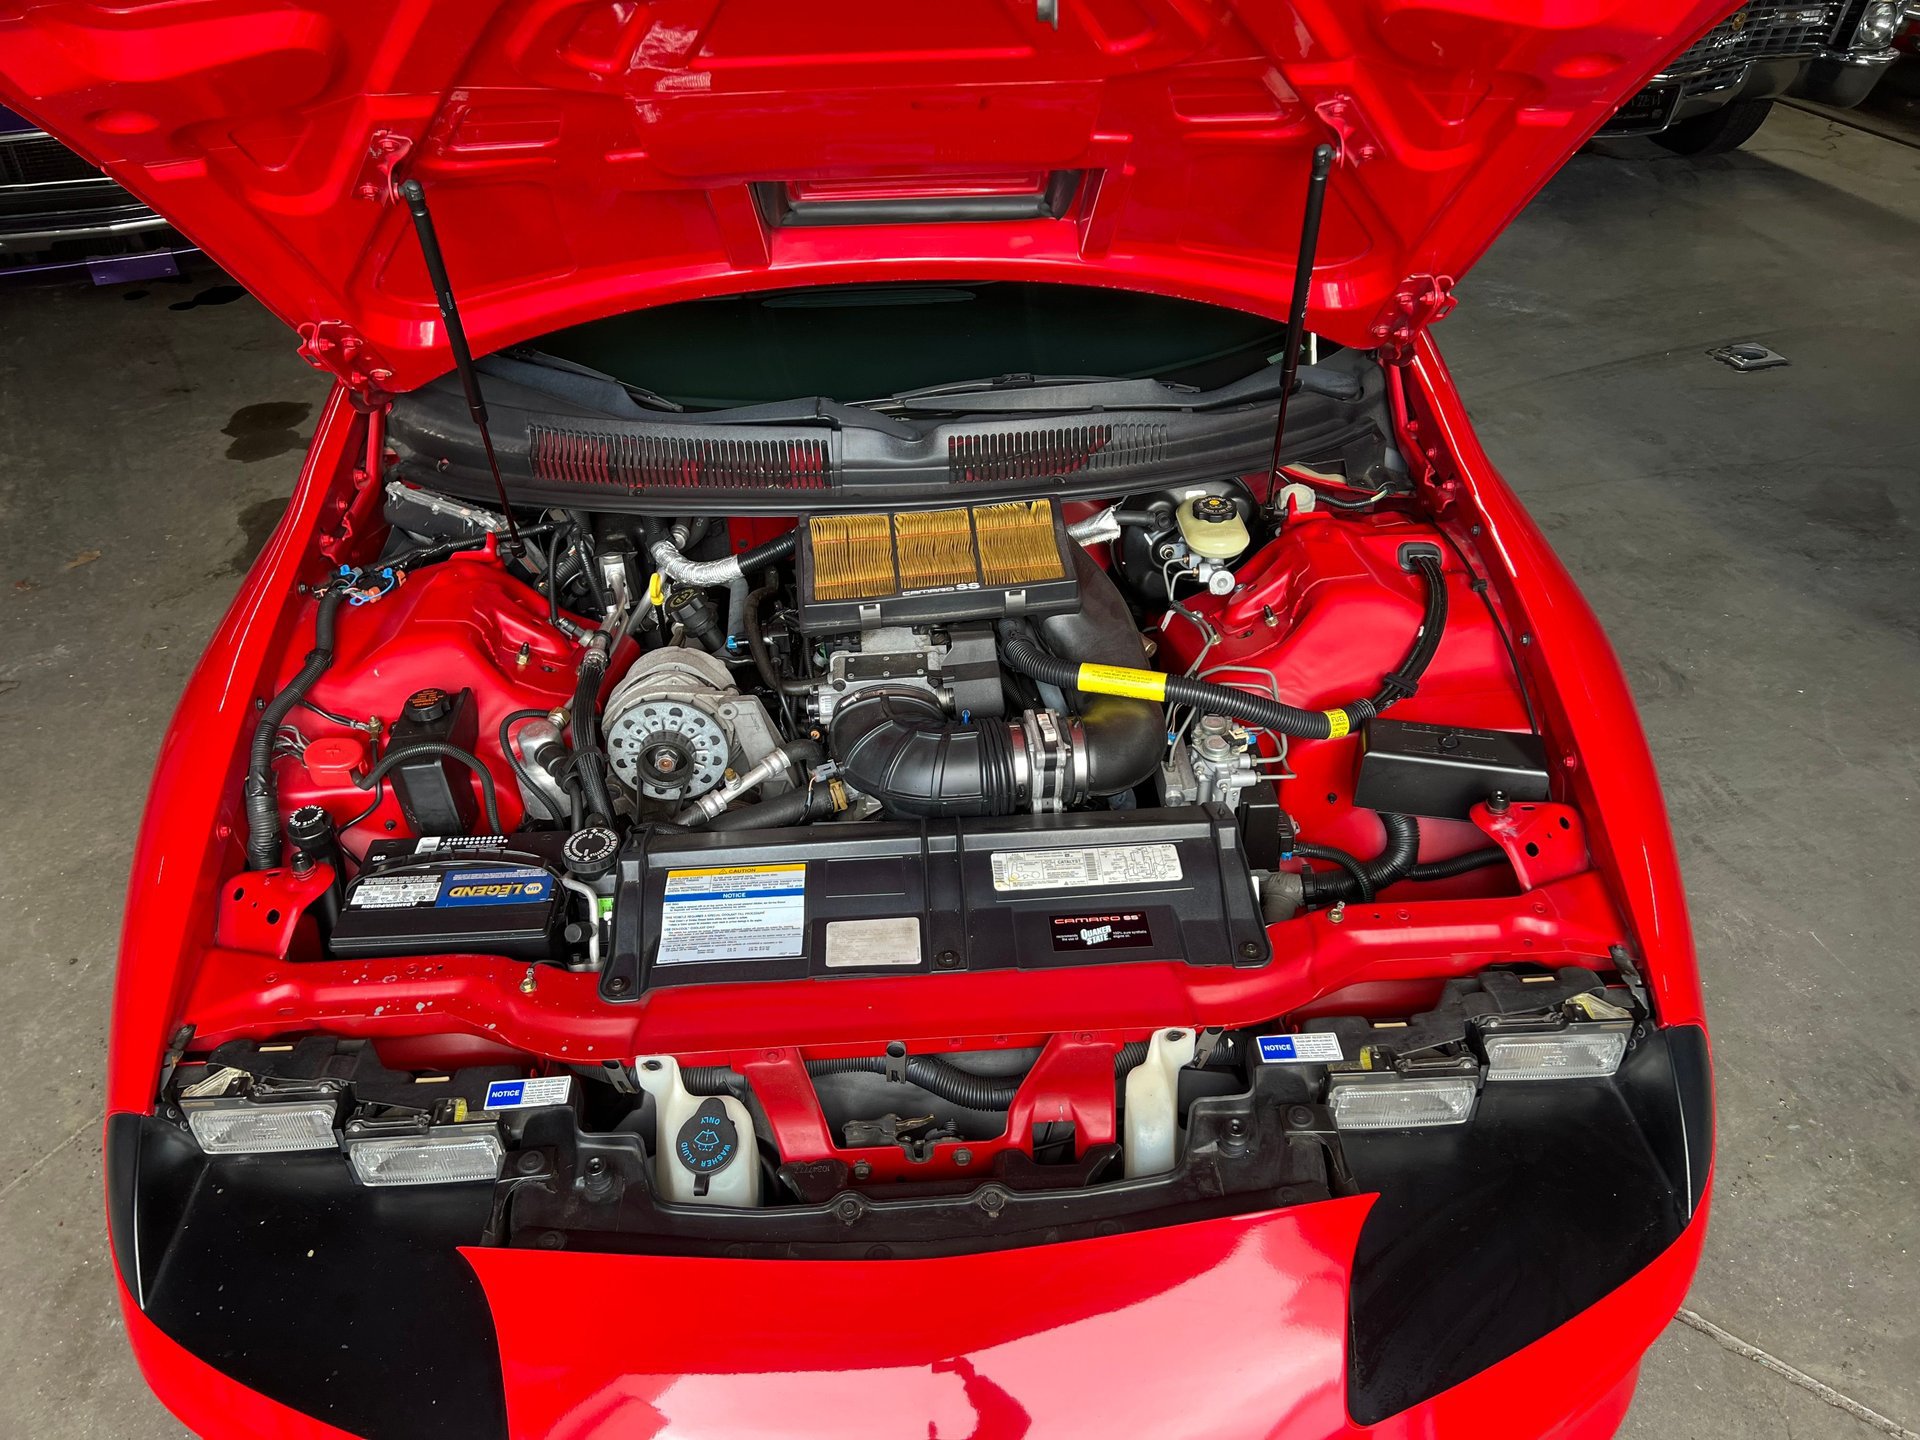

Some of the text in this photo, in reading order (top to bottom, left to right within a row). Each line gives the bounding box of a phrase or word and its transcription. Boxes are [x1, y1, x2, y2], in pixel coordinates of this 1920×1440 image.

[902, 582, 980, 596] CAMARO SS
[449, 884, 523, 897] LEGEND
[1054, 915, 1120, 924] CAMARO
[1080, 925, 1111, 940] QUAKER
[1086, 934, 1109, 945] STATE
[491, 1089, 520, 1098] NOTICE
[700, 1116, 720, 1125] ONLY
[681, 1141, 731, 1167] WASHER FLUID
